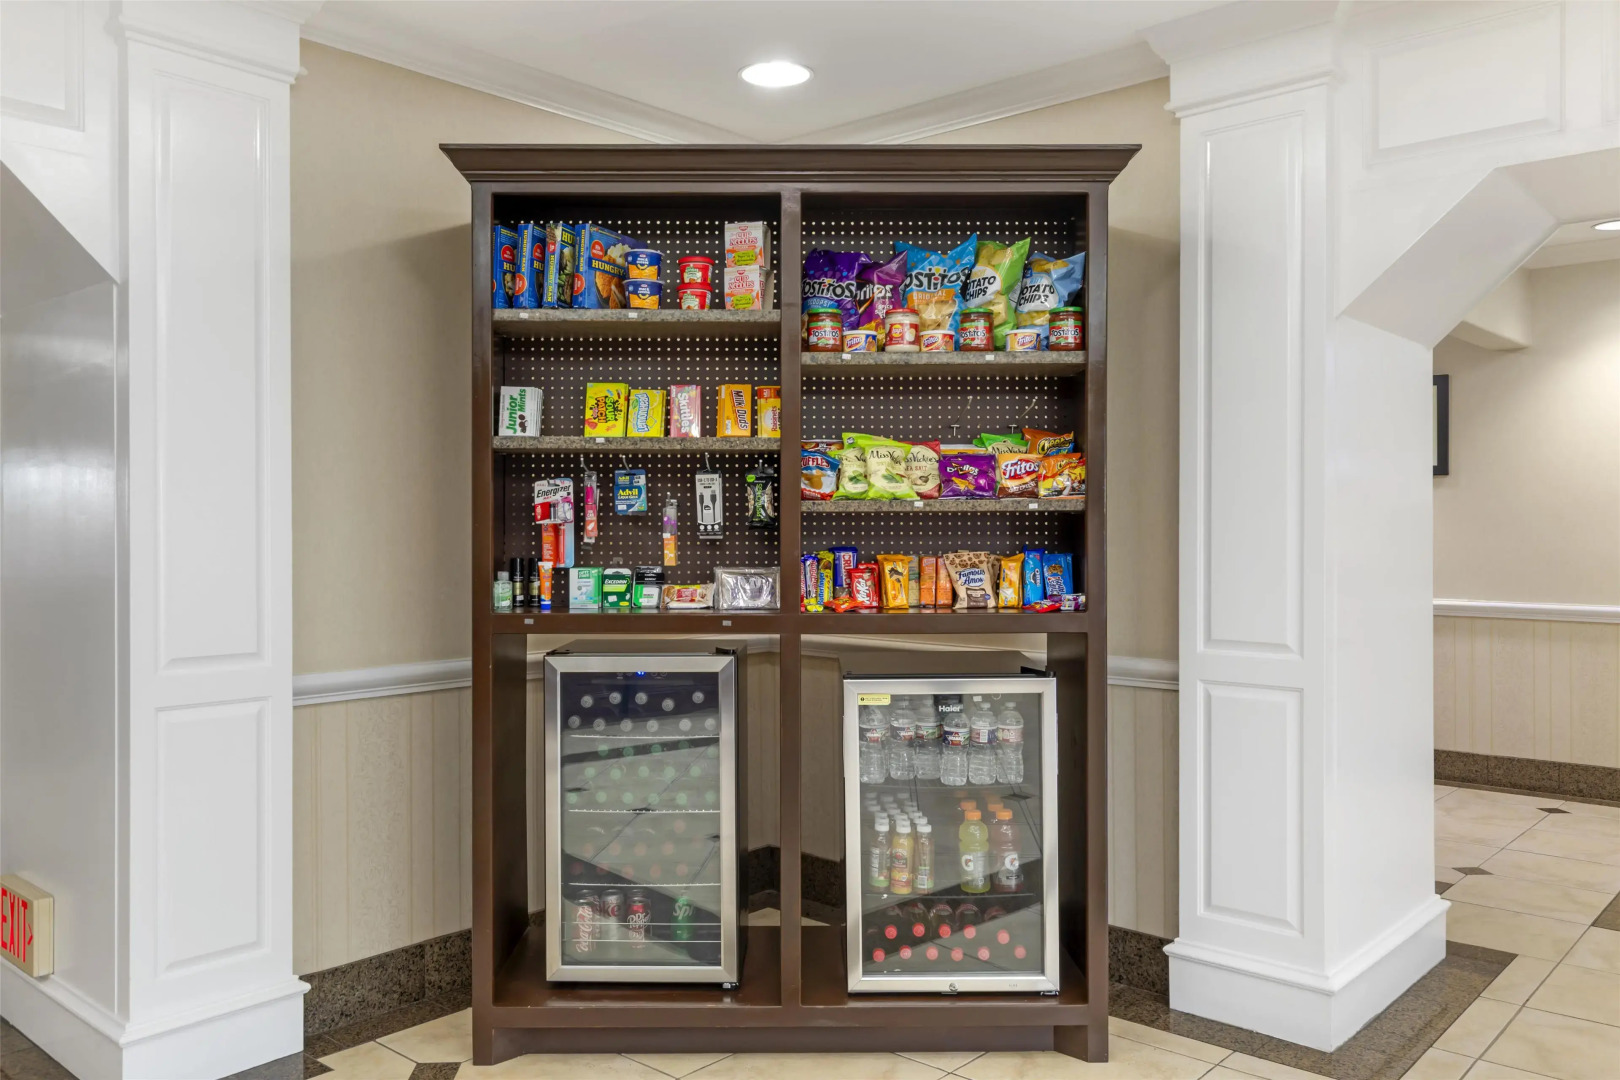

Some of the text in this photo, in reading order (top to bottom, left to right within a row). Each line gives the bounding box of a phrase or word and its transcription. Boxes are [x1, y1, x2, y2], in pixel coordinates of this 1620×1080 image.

[967, 275, 997, 290] OTATO
[1021, 284, 1055, 296] OTATO
[517, 388, 527, 412] Mints
[596, 396, 607, 423] PATCH
[605, 396, 616, 422] SOUR
[733, 389, 749, 431] Milk Duds
[505, 394, 519, 434] Junior
[677, 392, 693, 433] Skittles
[801, 456, 830, 468] UFFLES
[1001, 459, 1039, 479] Fritos
[536, 485, 572, 498] Energizer
[617, 488, 639, 496] Advil
[955, 568, 986, 582] Famous
[960, 576, 984, 587] Amos
[0, 886, 28, 963] EXIT
